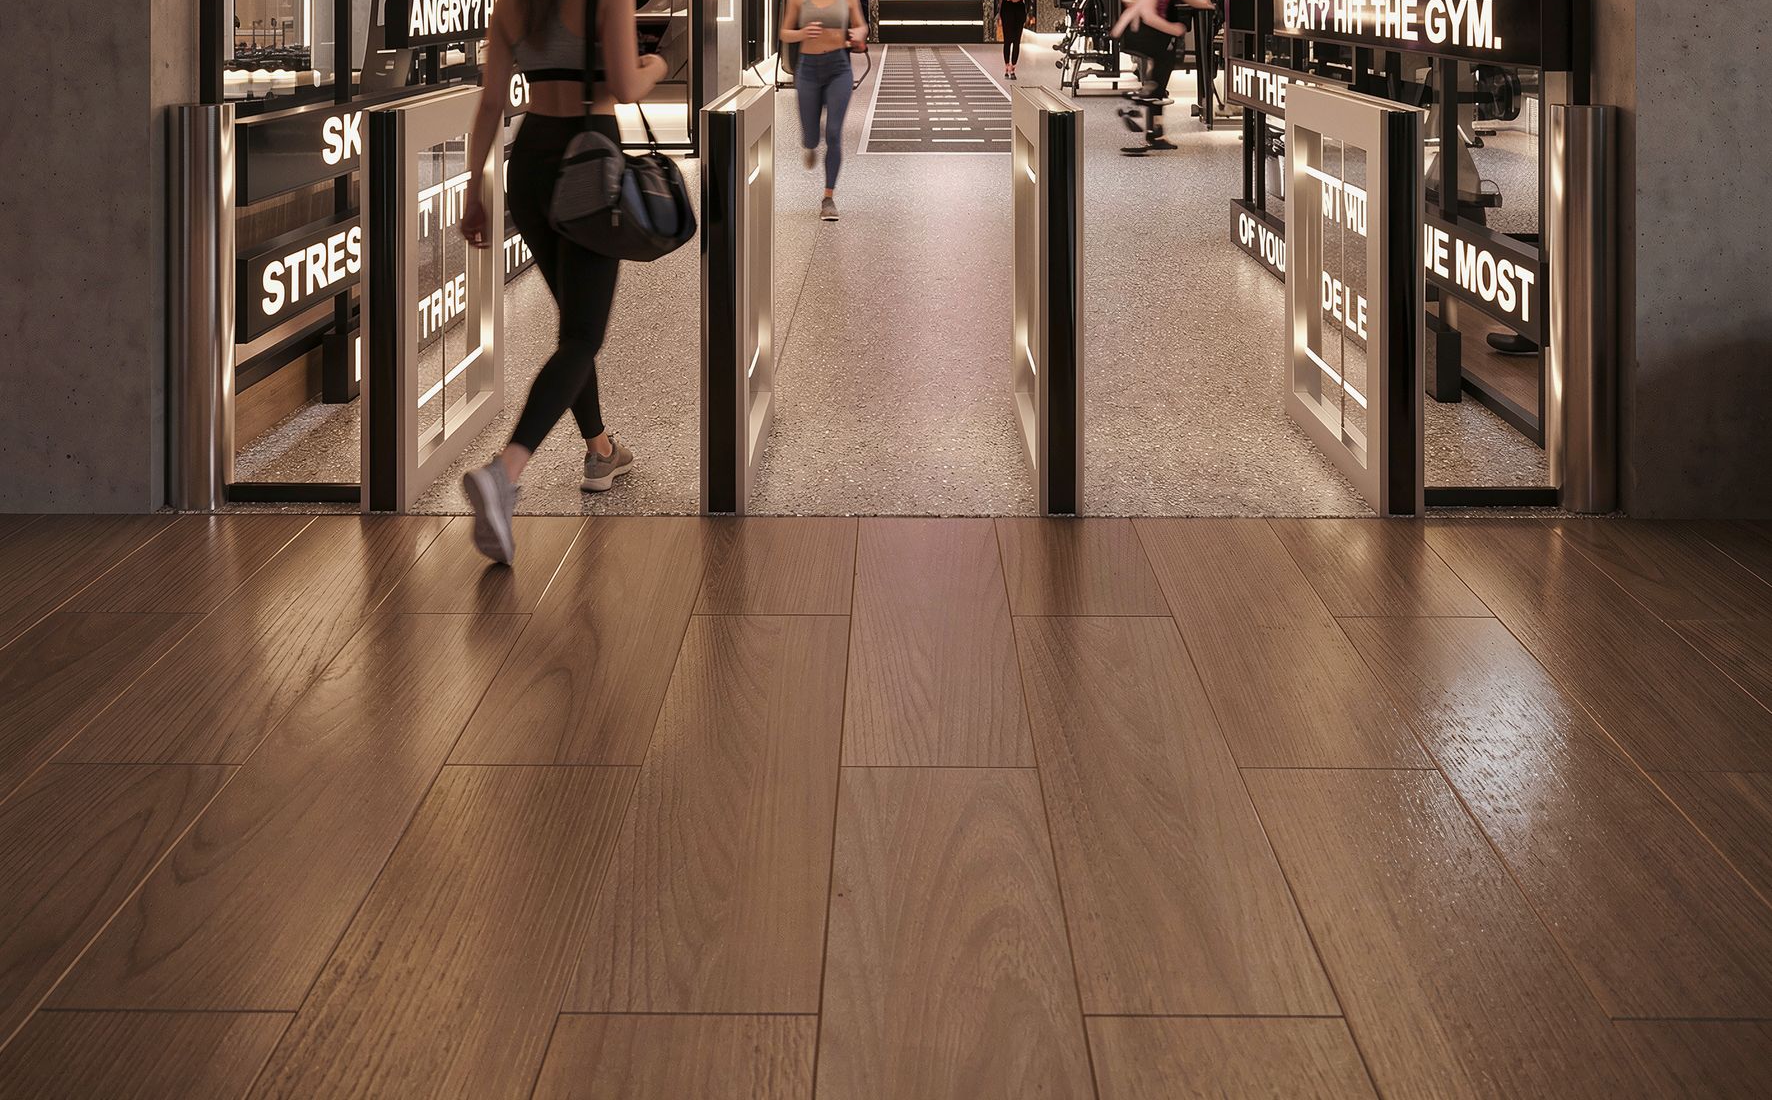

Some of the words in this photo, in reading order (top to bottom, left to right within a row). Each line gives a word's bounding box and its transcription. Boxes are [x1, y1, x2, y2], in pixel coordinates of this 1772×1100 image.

[1232, 64, 1255, 98] HIT
[1256, 70, 1289, 109] THE
[1239, 212, 1256, 248] OF
[1455, 238, 1535, 322] MOST
